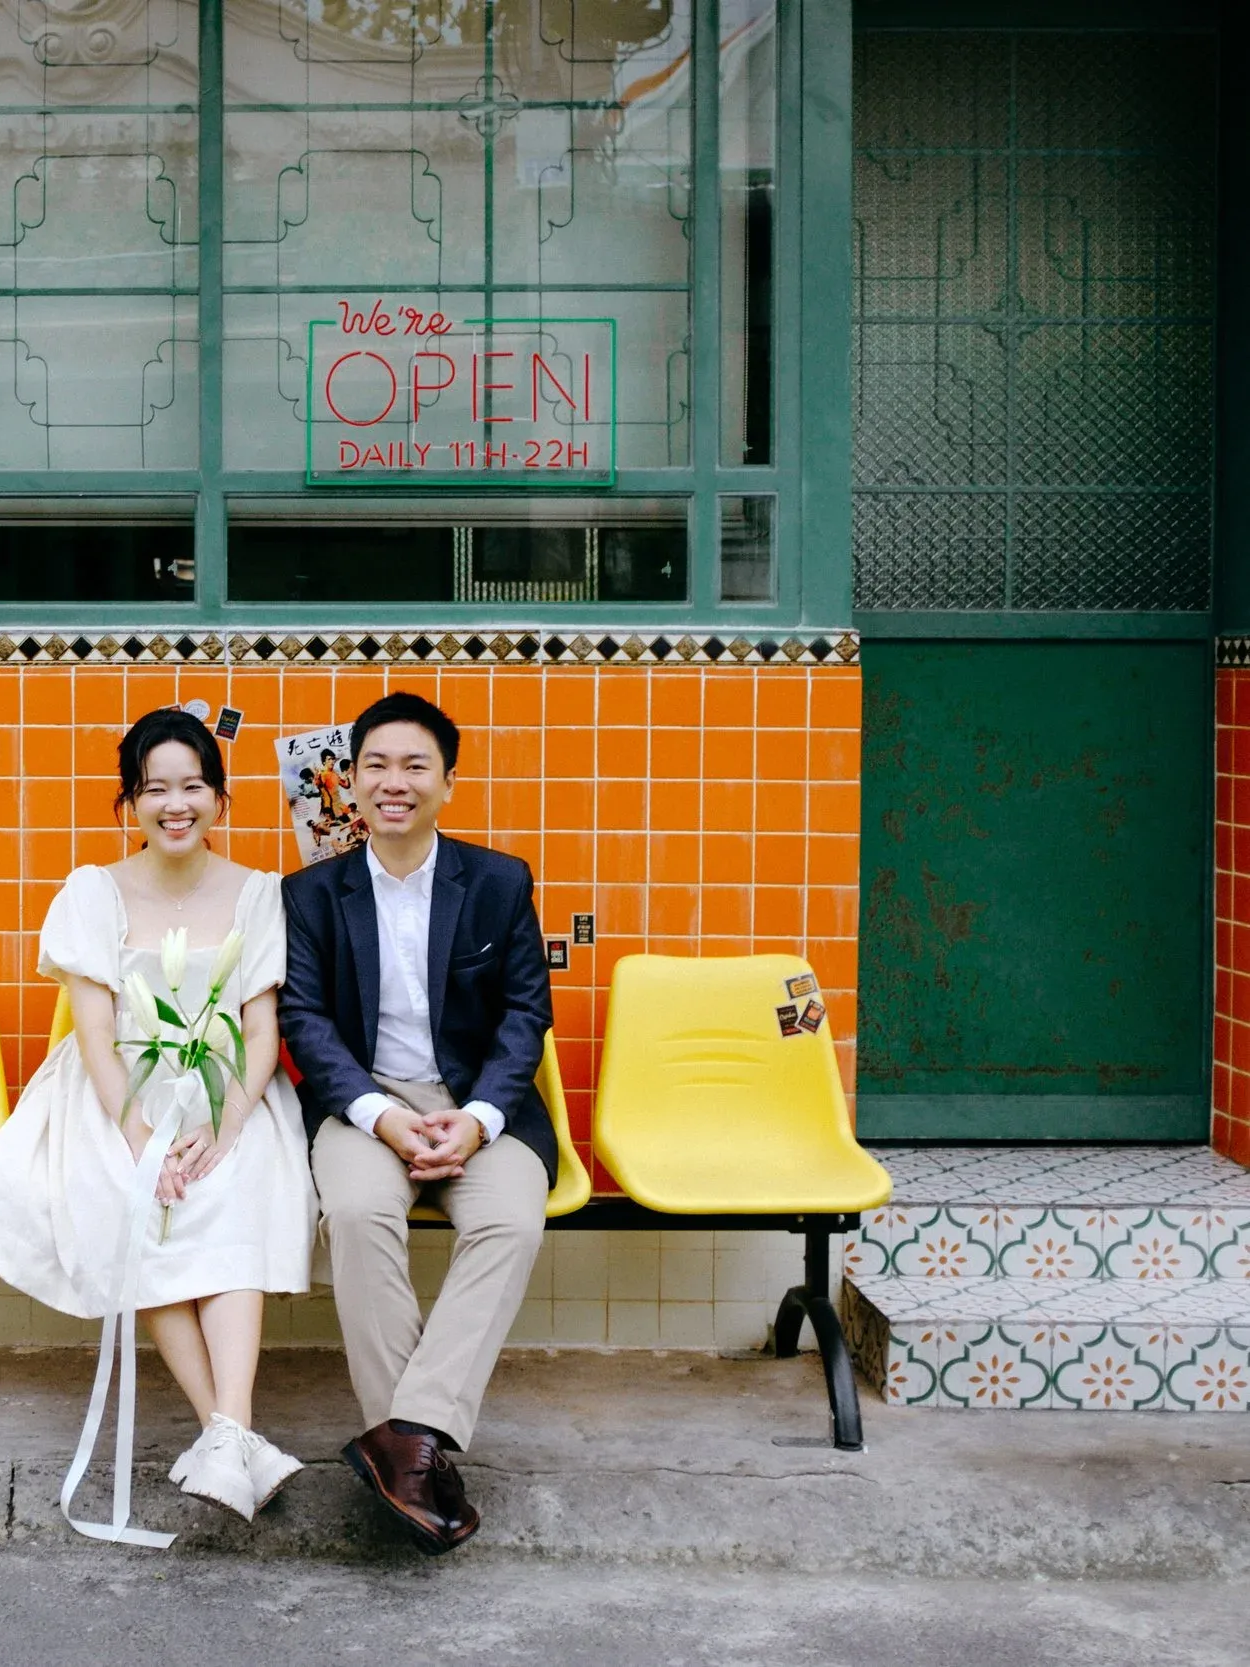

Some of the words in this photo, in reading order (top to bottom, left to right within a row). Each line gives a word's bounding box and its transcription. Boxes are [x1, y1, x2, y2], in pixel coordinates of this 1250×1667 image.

[338, 299, 454, 336] We're
[325, 351, 590, 427] OPEN
[339, 440, 432, 468] DAILY
[287, 727, 353, 756] 死亡遊
